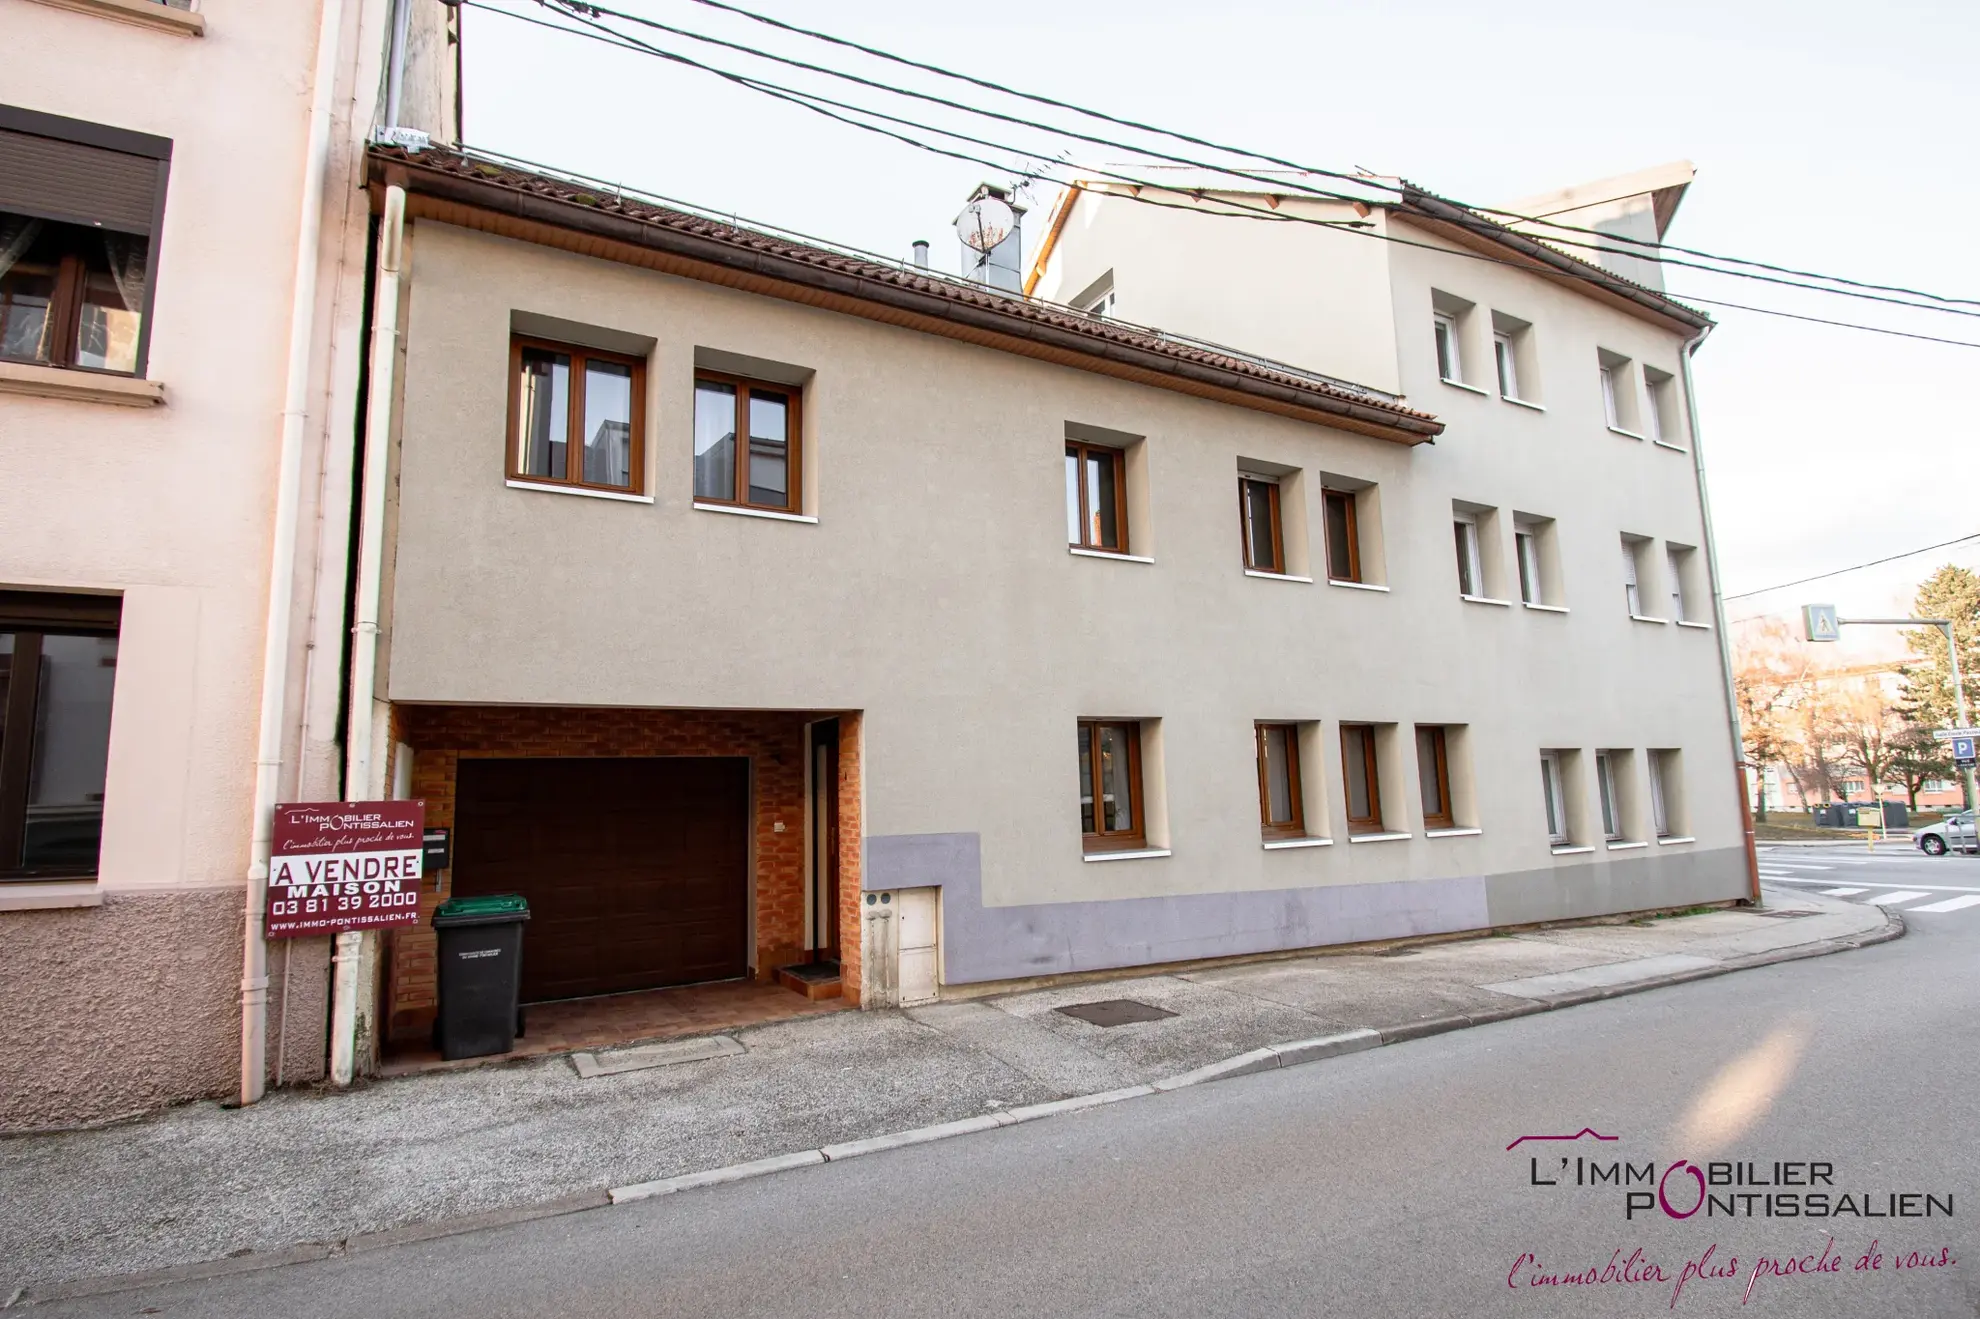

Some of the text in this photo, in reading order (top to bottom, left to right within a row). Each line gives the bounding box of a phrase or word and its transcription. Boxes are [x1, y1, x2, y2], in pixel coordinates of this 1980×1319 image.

[1957, 742, 1968, 755] P
[291, 814, 381, 827] L'IMMOBILIER
[319, 818, 414, 832] PONTISSALIEN
[332, 835, 353, 852] plus
[353, 832, 382, 851] proche
[385, 832, 394, 841] de
[275, 855, 417, 885] A VENDRE
[287, 880, 401, 899] MAISON
[272, 892, 417, 915] 03 81 39 2000
